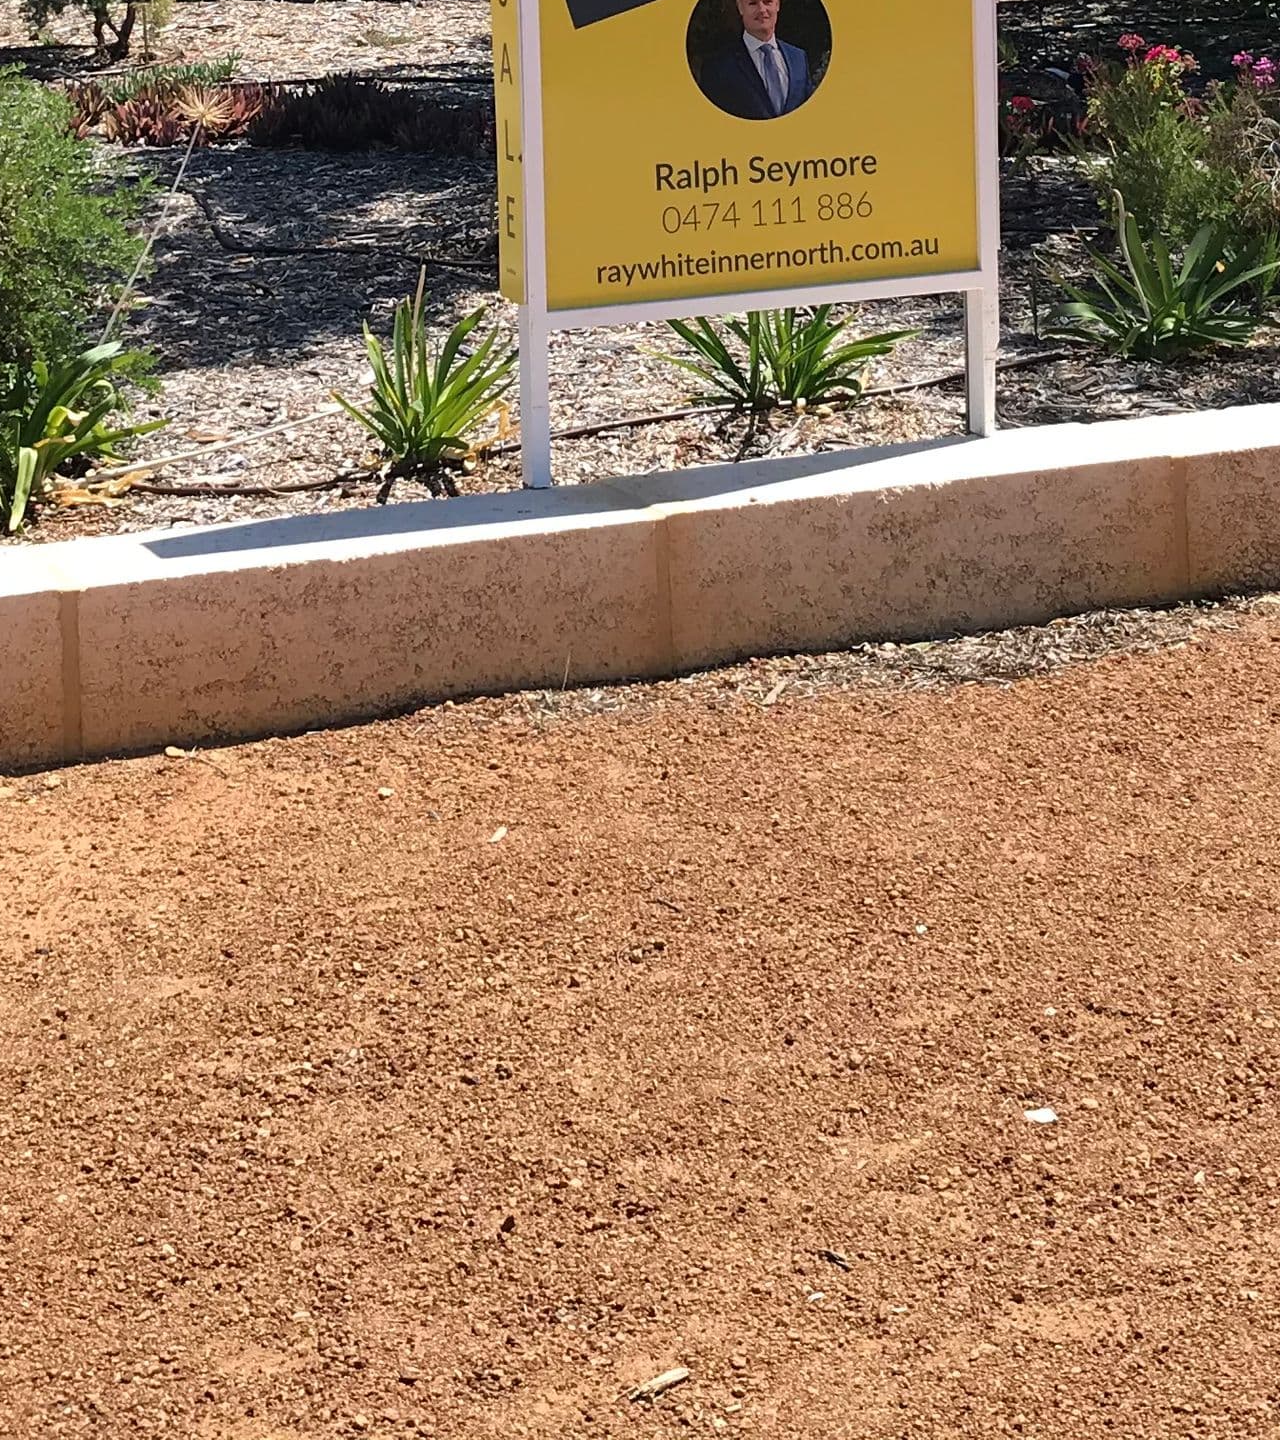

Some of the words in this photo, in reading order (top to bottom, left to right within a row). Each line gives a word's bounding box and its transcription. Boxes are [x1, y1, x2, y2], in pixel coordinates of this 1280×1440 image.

[655, 158, 738, 194] Ralph
[748, 154, 877, 187] Seymore
[662, 201, 741, 234] 0474
[751, 196, 807, 227] 111
[817, 190, 873, 222] 886
[597, 237, 939, 287] raywhiteinnernorth.com.au
